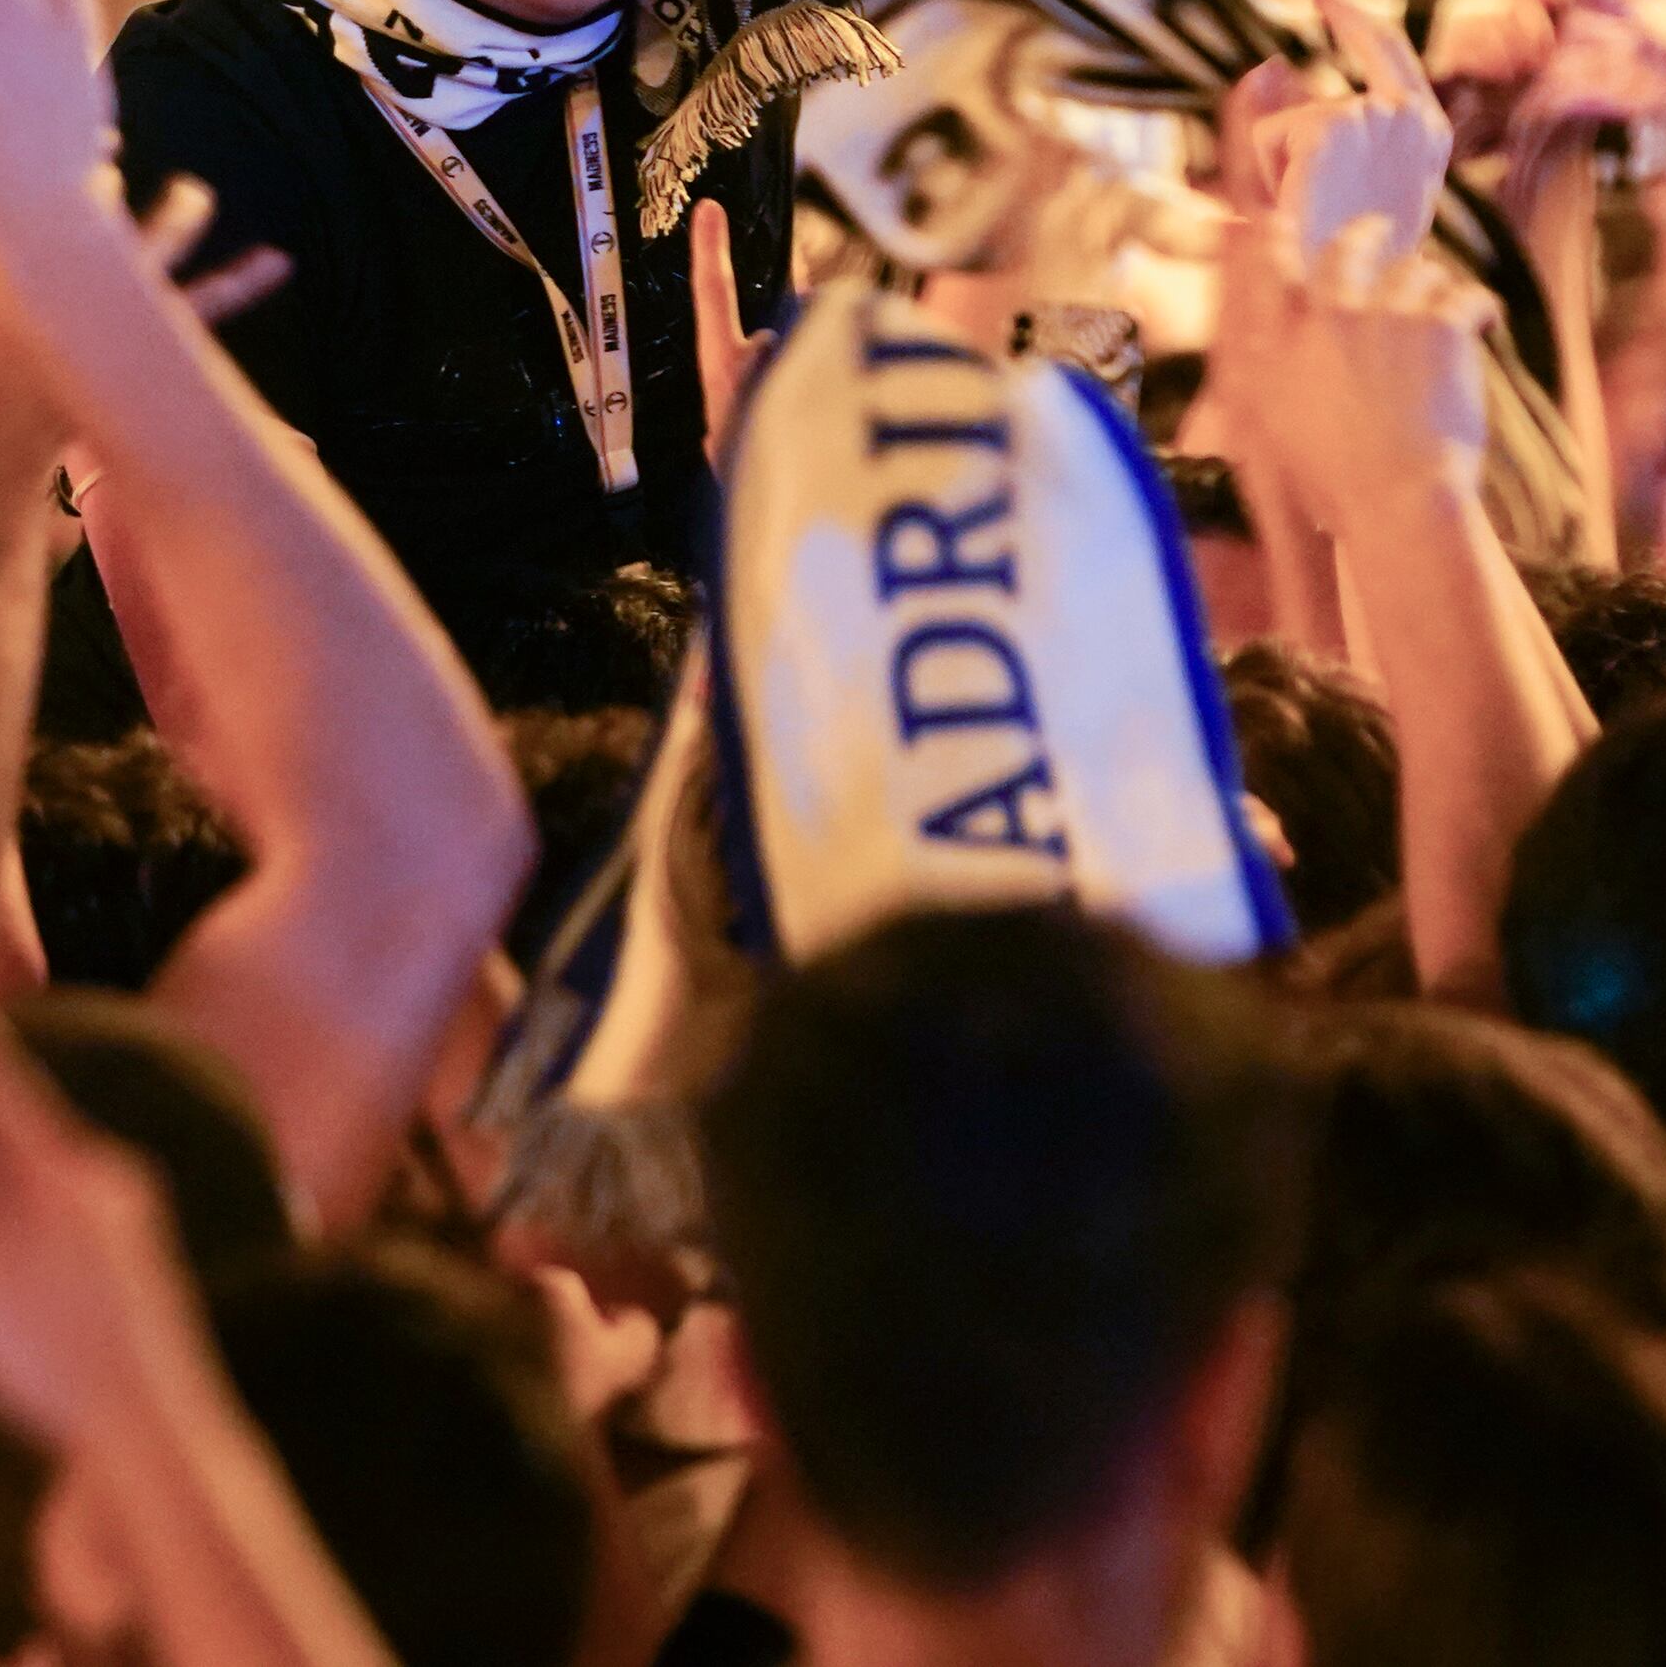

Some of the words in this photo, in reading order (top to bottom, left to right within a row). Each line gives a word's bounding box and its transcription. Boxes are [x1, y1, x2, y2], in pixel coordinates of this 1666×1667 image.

[582, 132, 604, 191] MADNESS
[600, 294, 620, 352] MADNESS
[863, 329, 1071, 864] ADRI
